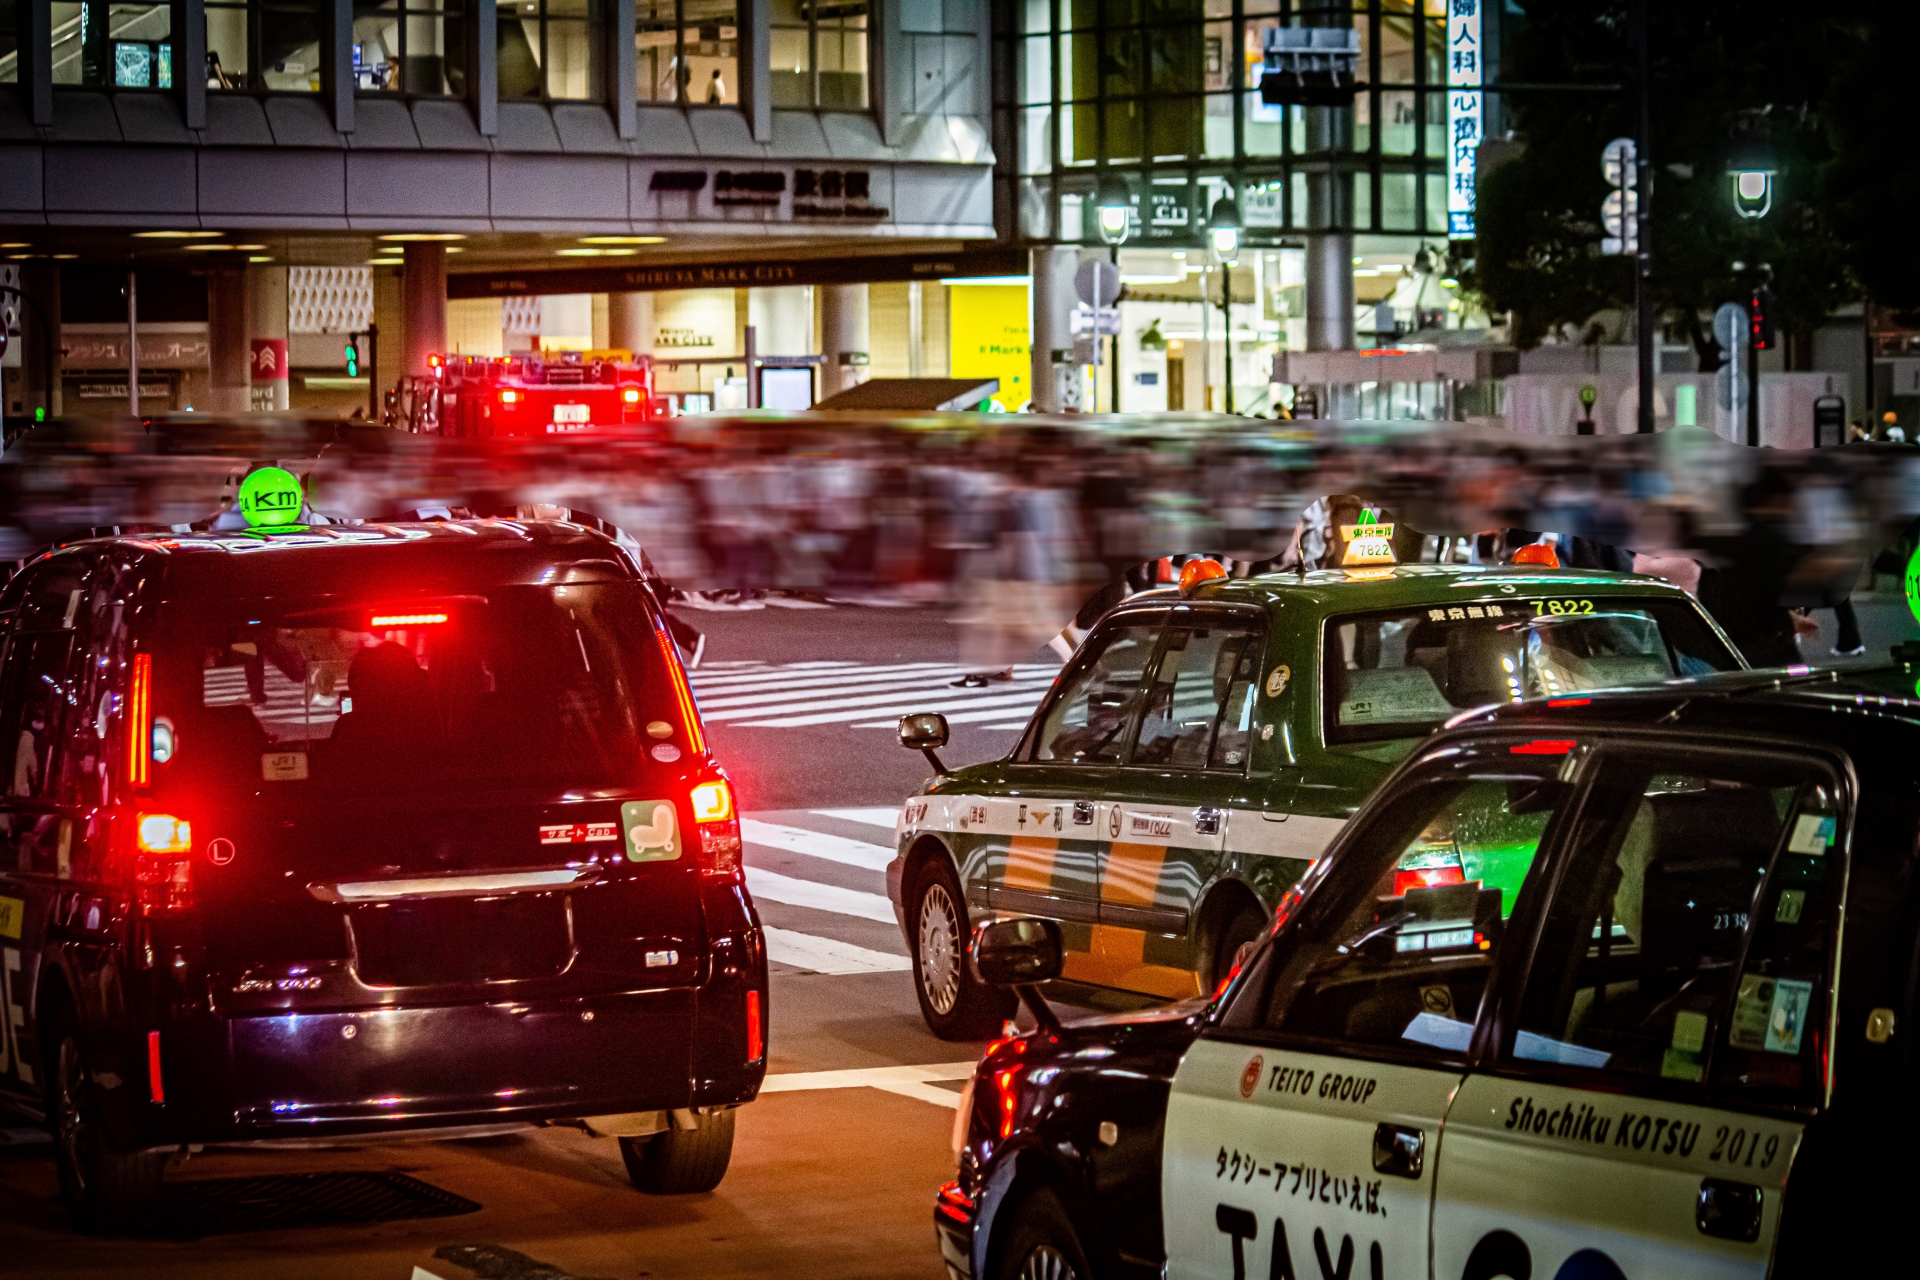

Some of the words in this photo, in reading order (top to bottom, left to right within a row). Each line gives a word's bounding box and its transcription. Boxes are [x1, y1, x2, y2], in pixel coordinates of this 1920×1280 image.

[1359, 544, 1390, 556] 7822
[1428, 605, 1504, 622] 東京無線
[1530, 600, 1598, 616] 7822
[547, 829, 584, 839] サポート
[588, 827, 611, 837] Cab
[1268, 1066, 1315, 1095] TEITO
[1319, 1073, 1377, 1104] GROUP
[1505, 1097, 1611, 1144] Shochiku
[1614, 1112, 1701, 1158] KOTSU
[1709, 1125, 1780, 1169] 2019
[1216, 1145, 1388, 1218] タクシーアプリといえば、
